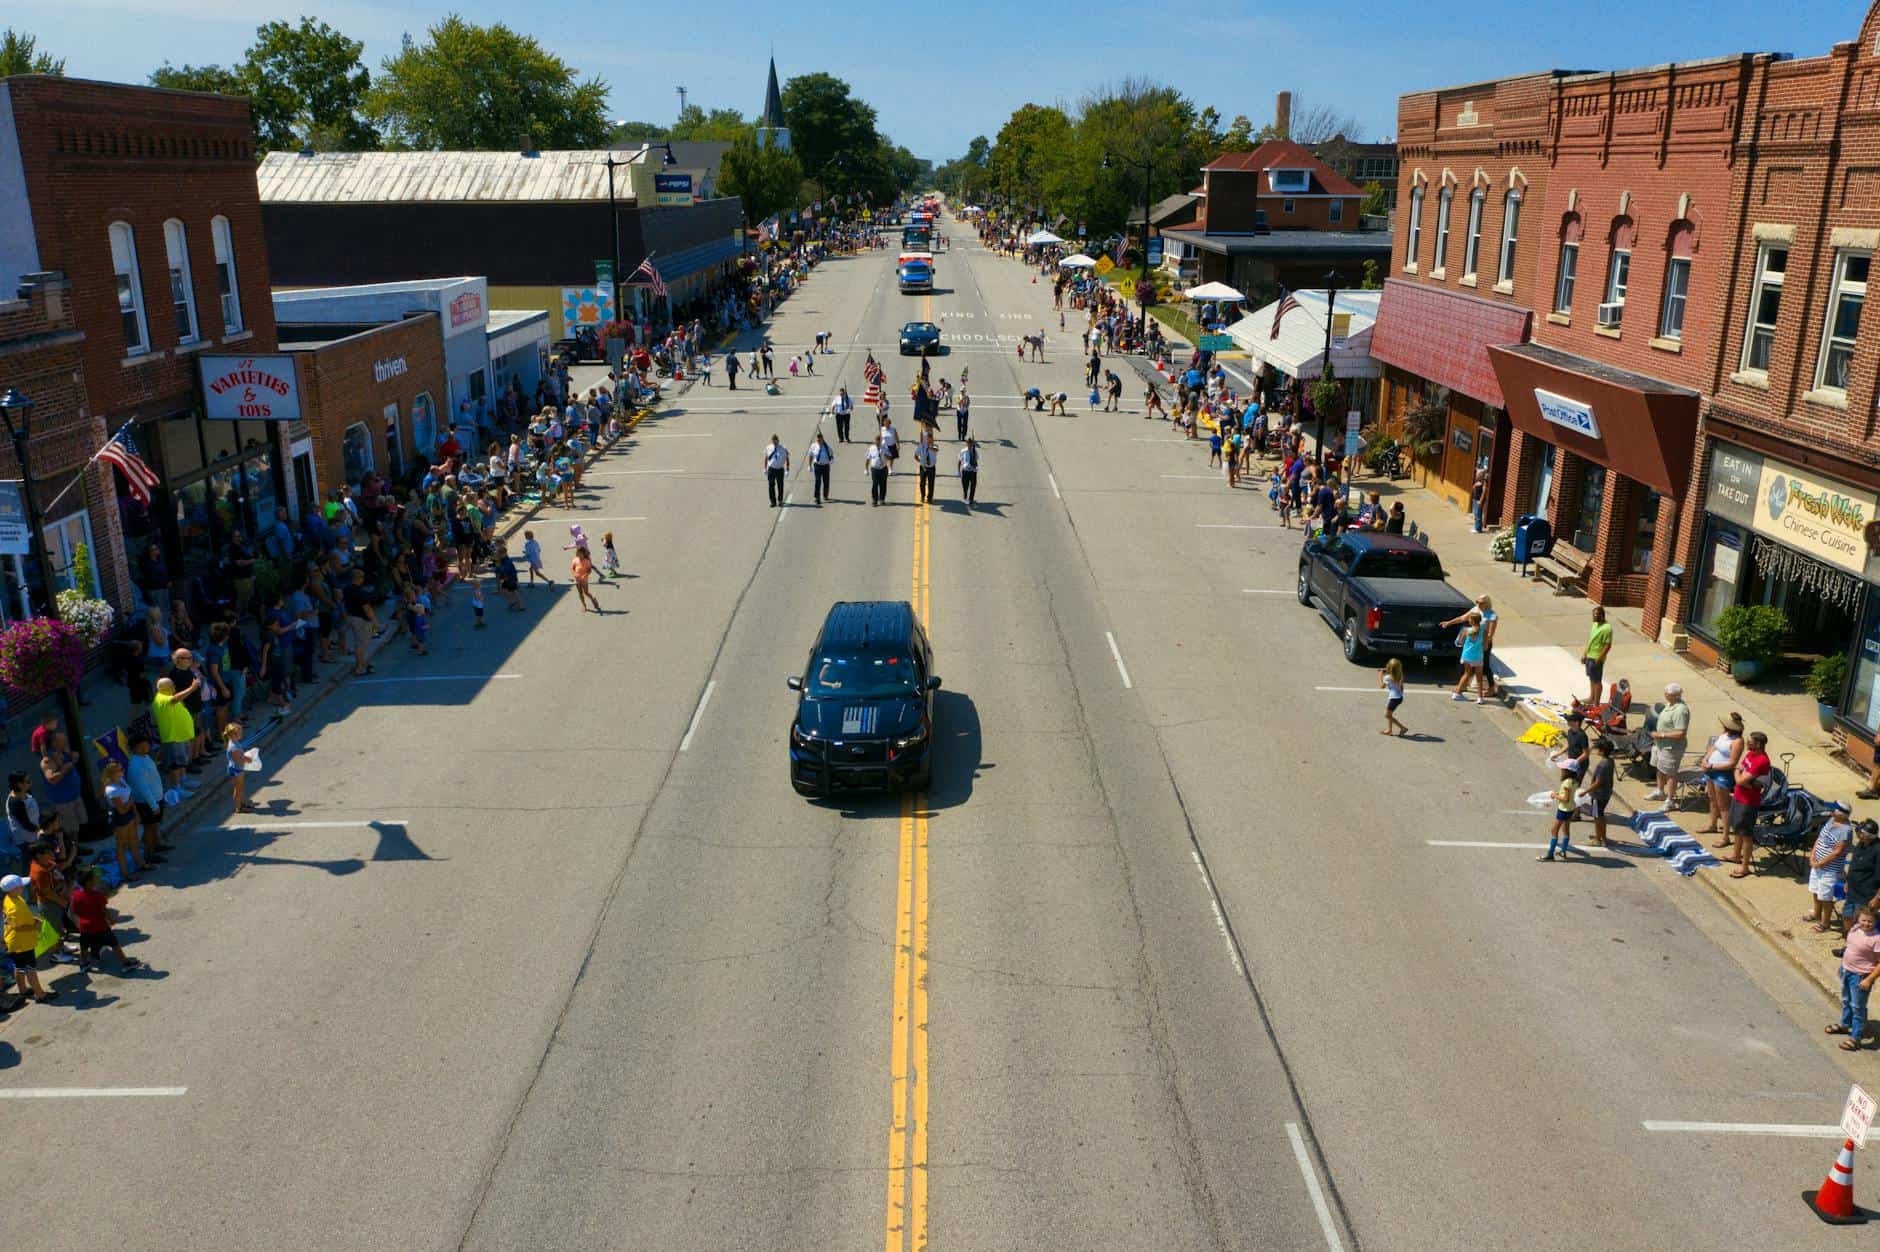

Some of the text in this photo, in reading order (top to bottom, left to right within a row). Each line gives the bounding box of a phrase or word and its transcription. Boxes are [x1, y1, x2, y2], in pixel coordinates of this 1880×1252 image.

[210, 370, 290, 397] VARIETIES
[243, 387, 257, 402] &
[238, 404, 271, 417] TOYS
[1723, 456, 1753, 475] EAT IN
[1718, 482, 1749, 505] TAKE OUT
[1788, 480, 1829, 519] Fresh
[1783, 514, 1820, 541] Chinese
[1820, 529, 1857, 557] Cuisine
